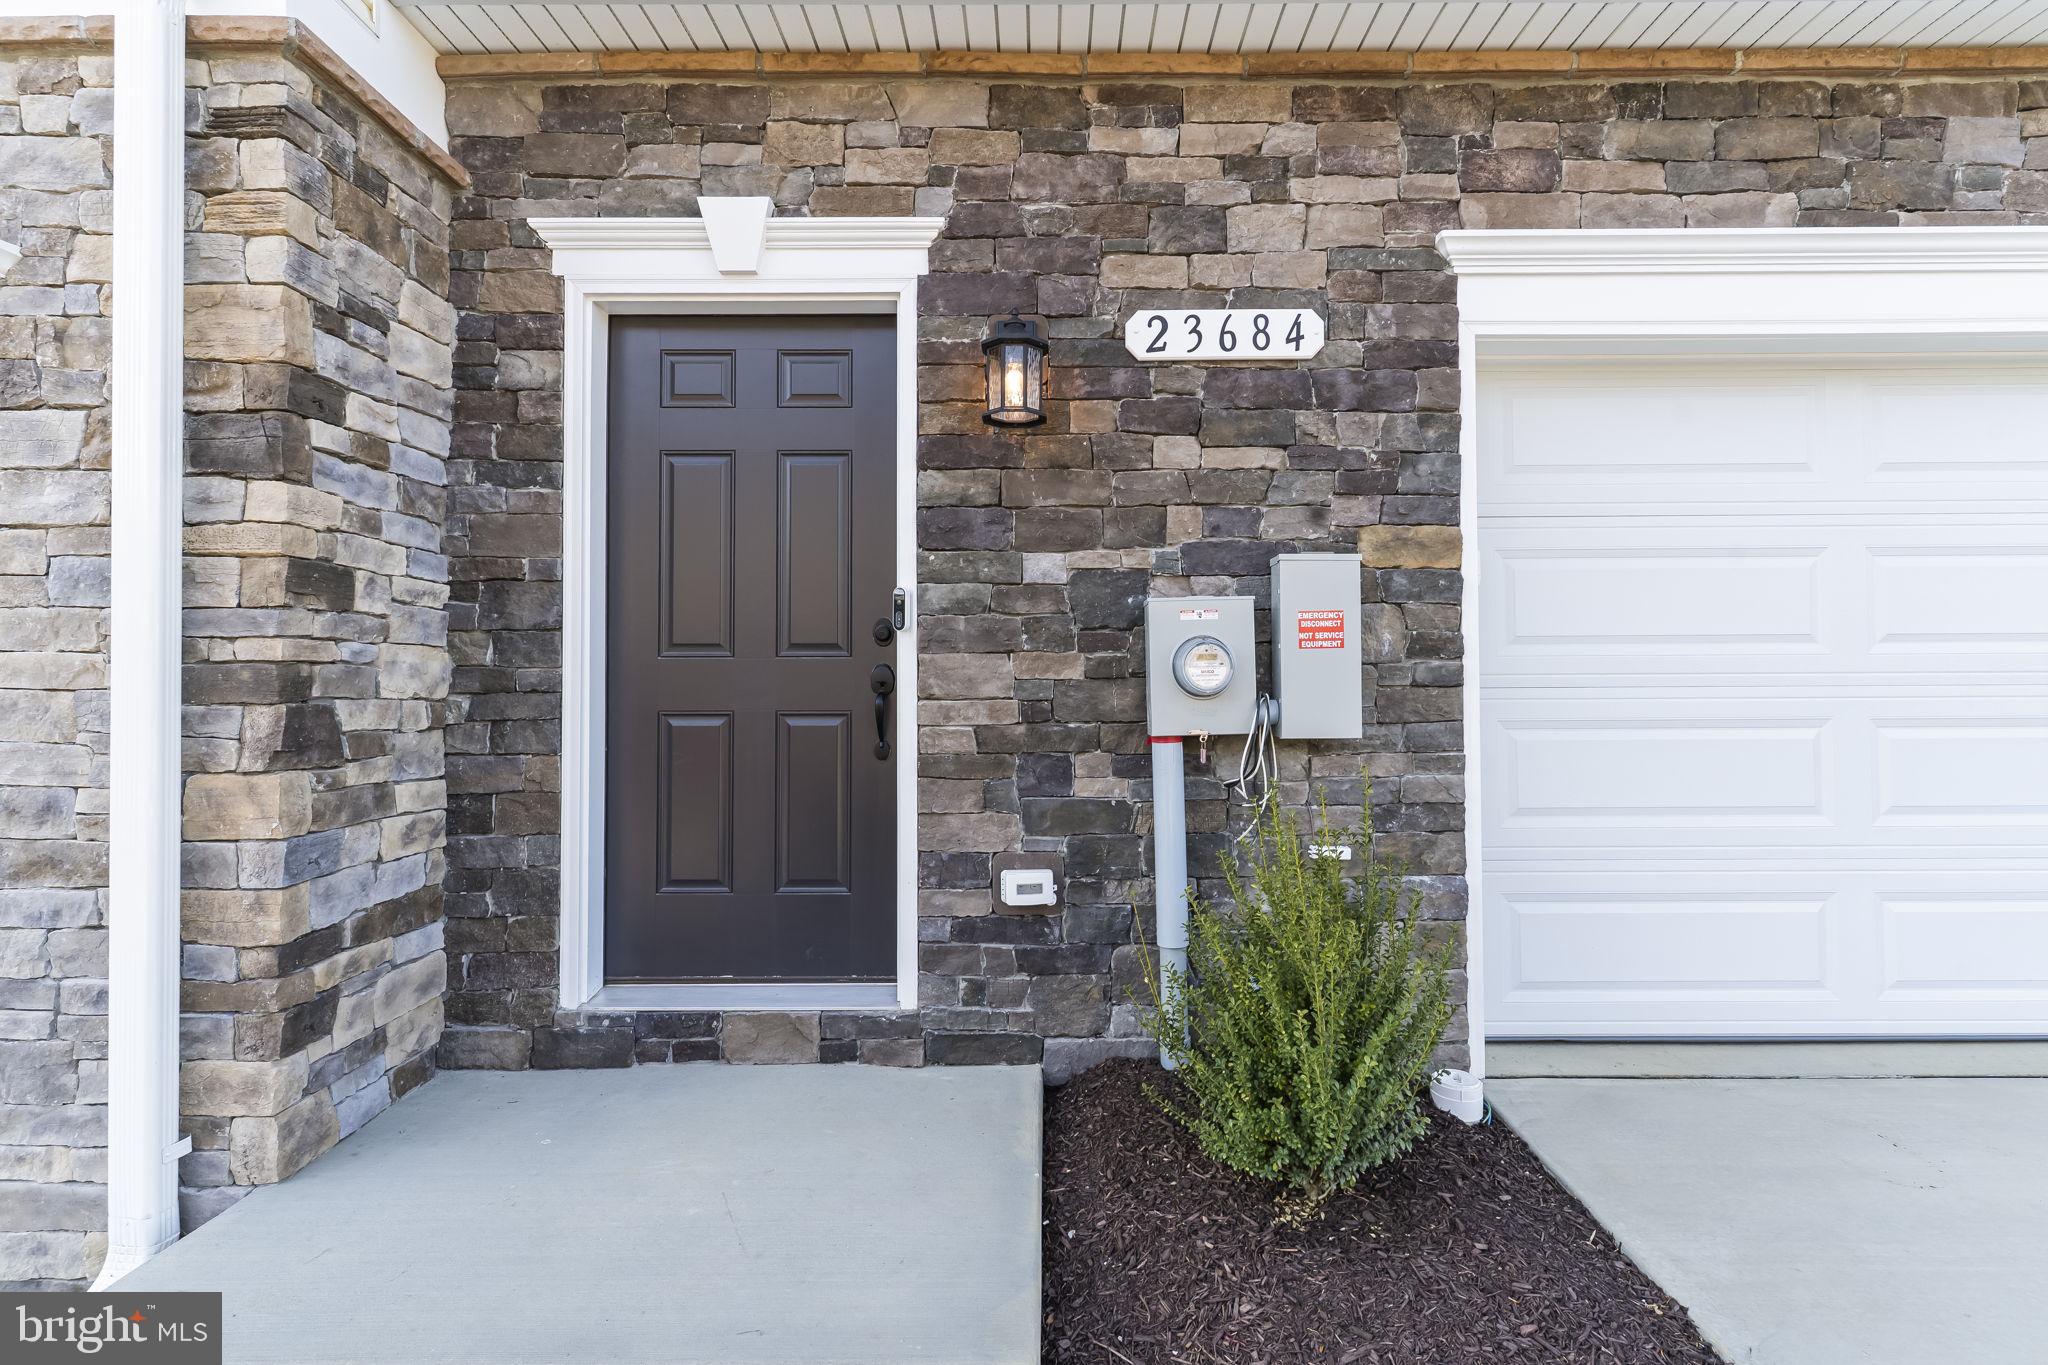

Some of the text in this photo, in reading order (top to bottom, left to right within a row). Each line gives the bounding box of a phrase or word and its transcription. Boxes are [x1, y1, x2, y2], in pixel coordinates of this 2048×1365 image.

[1146, 313, 1305, 353] 23684
[1300, 620, 1342, 628] DISCONNECT
[1299, 631, 1344, 640] NOT SERVICE
[1301, 640, 1342, 648] EQUIPMENT
